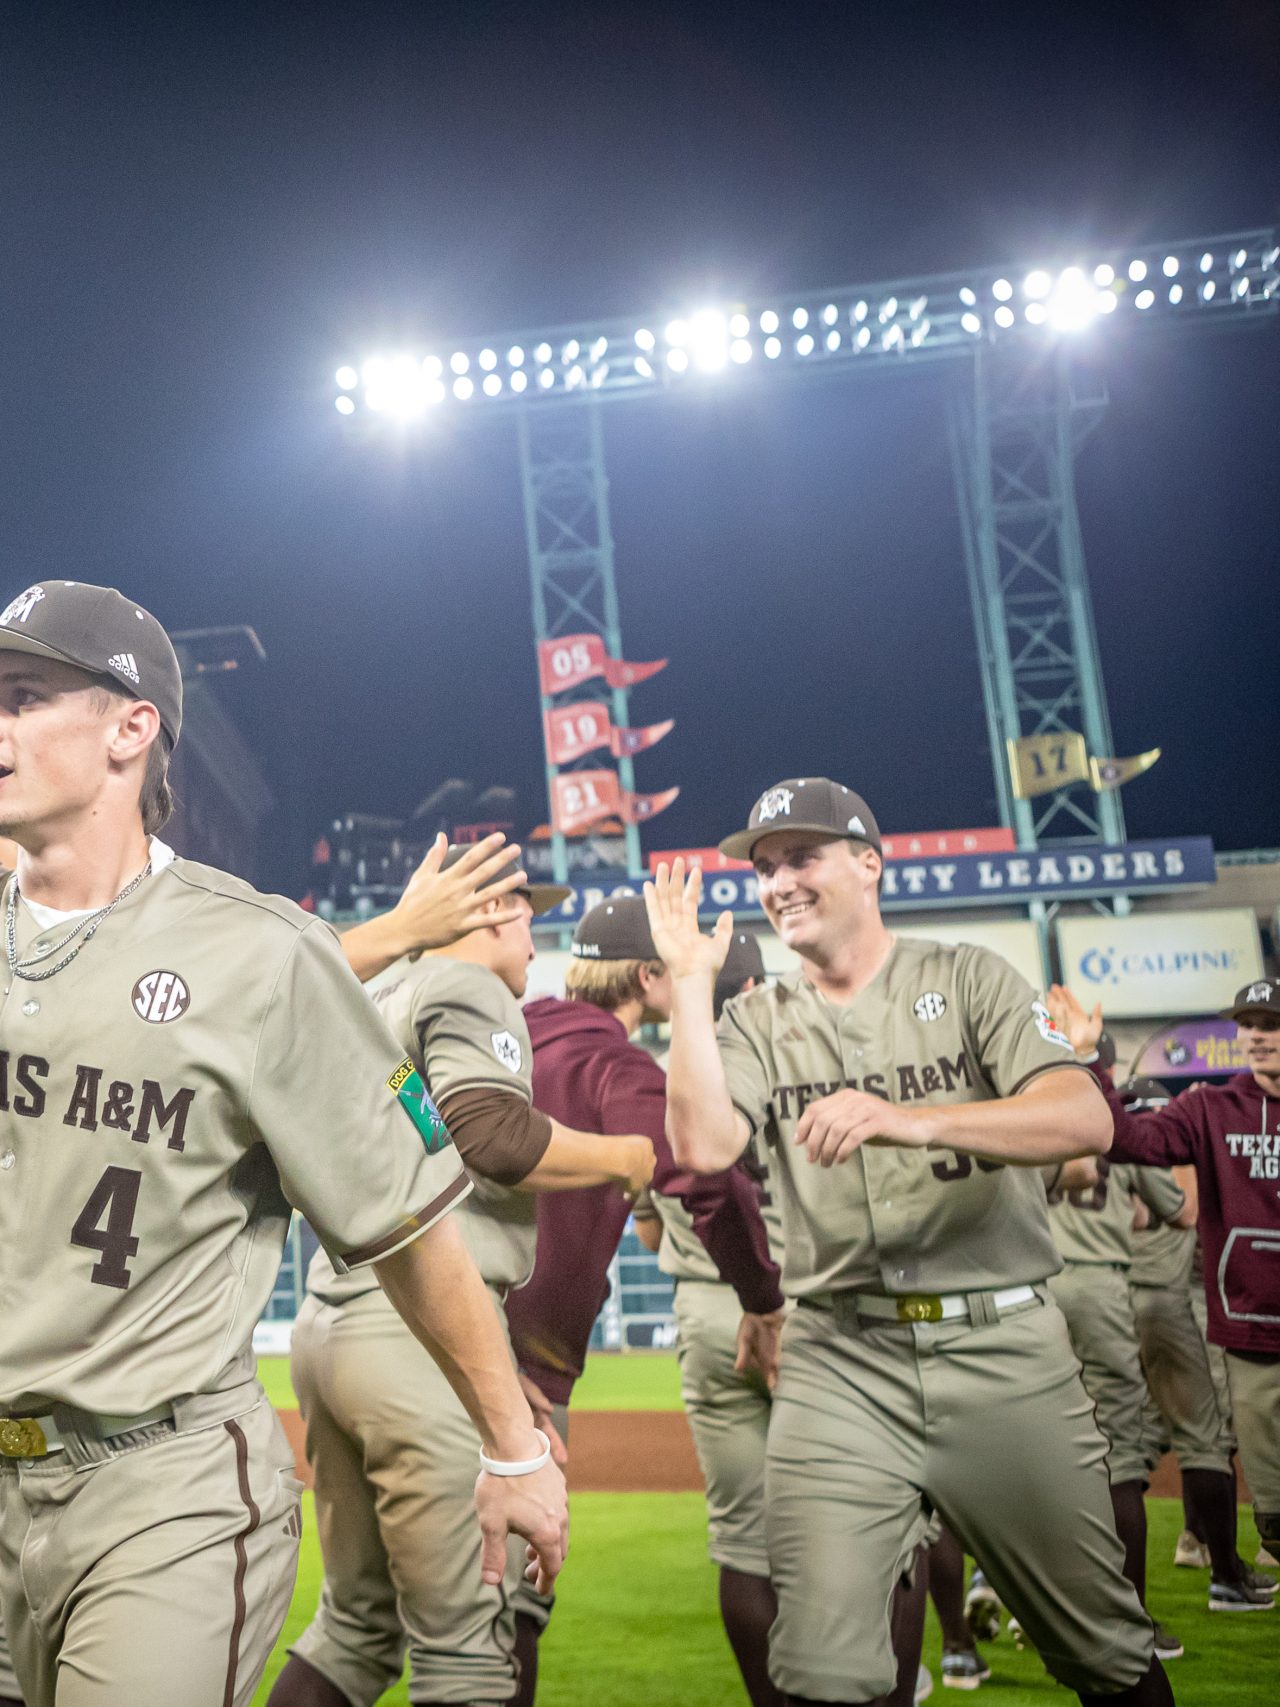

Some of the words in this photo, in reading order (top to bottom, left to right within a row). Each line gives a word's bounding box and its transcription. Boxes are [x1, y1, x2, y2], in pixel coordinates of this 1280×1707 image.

[108, 658, 140, 684] adidas
[552, 643, 591, 677] 05
[1032, 744, 1067, 778] 17
[563, 782, 599, 813] 21
[978, 849, 1185, 889] LEADERS
[1122, 951, 1239, 973] CALPINE
[135, 972, 187, 1021] SEC
[915, 992, 945, 1021] SEC
[390, 1067, 408, 1088] DOG
[897, 1052, 973, 1101] A&M
[63, 1064, 196, 1152] A&M
[70, 1165, 142, 1290] 4
